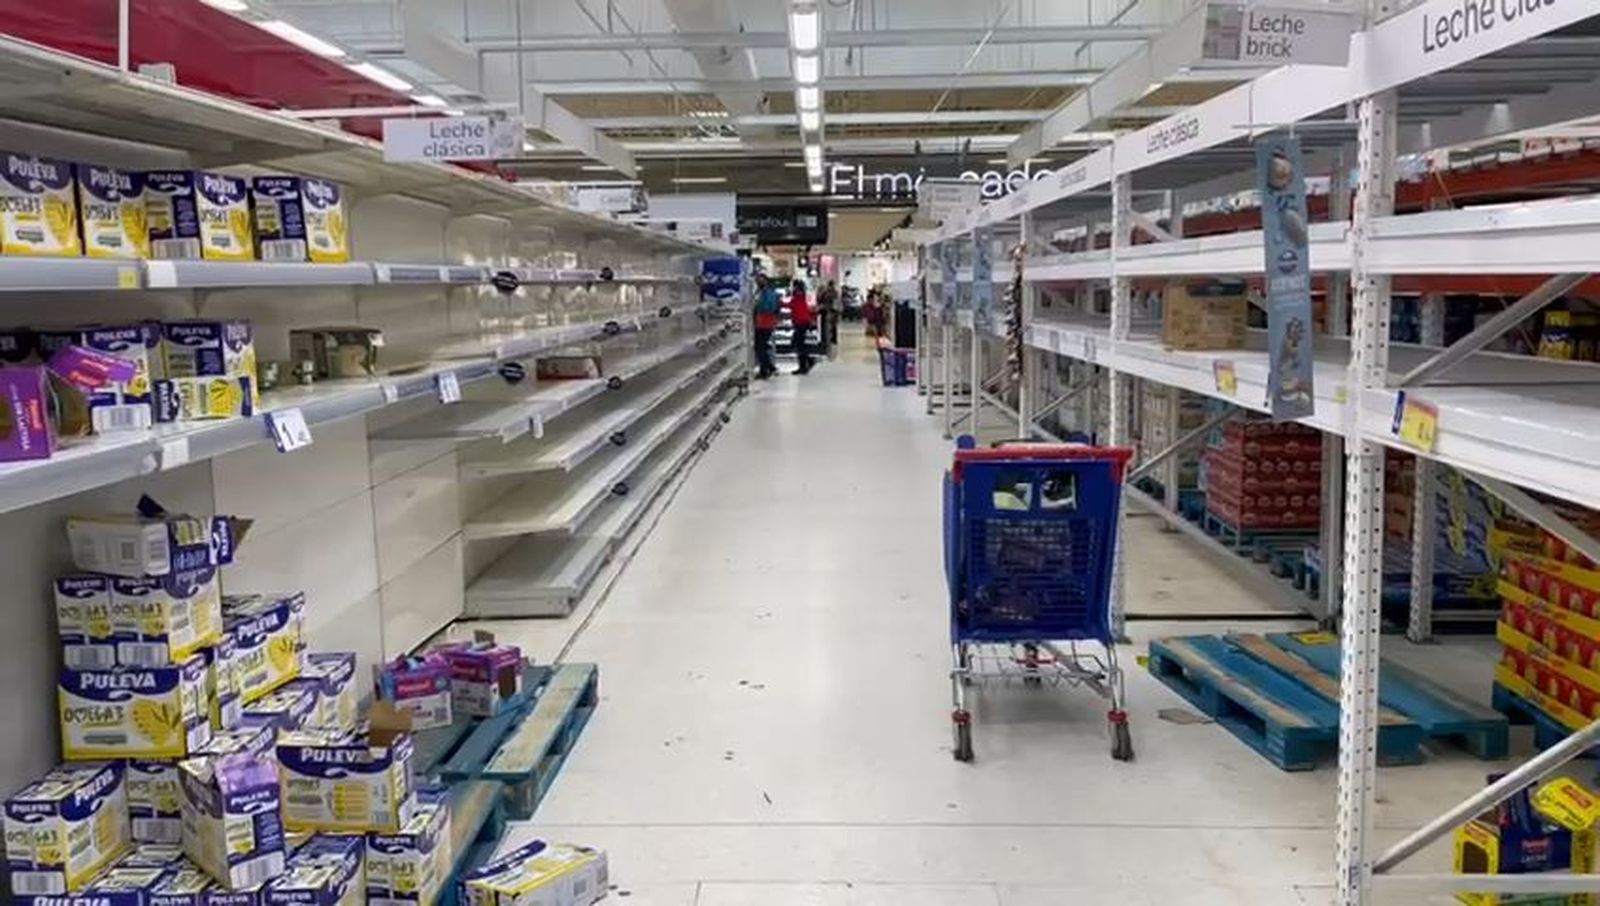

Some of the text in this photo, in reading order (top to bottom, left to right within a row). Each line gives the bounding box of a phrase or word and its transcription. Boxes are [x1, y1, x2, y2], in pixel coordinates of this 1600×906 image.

[1248, 12, 1304, 35] Leche
[1246, 35, 1292, 58] brick
[429, 118, 485, 138] Leche
[423, 138, 485, 157] clásica
[8, 155, 58, 181] PULEVA
[90, 167, 132, 192] PULEVA
[831, 165, 863, 193] El
[237, 611, 280, 641] PULEVA
[79, 672, 157, 690] PULEVA
[301, 747, 361, 763] PULEV
[73, 768, 115, 808] PULEVA
